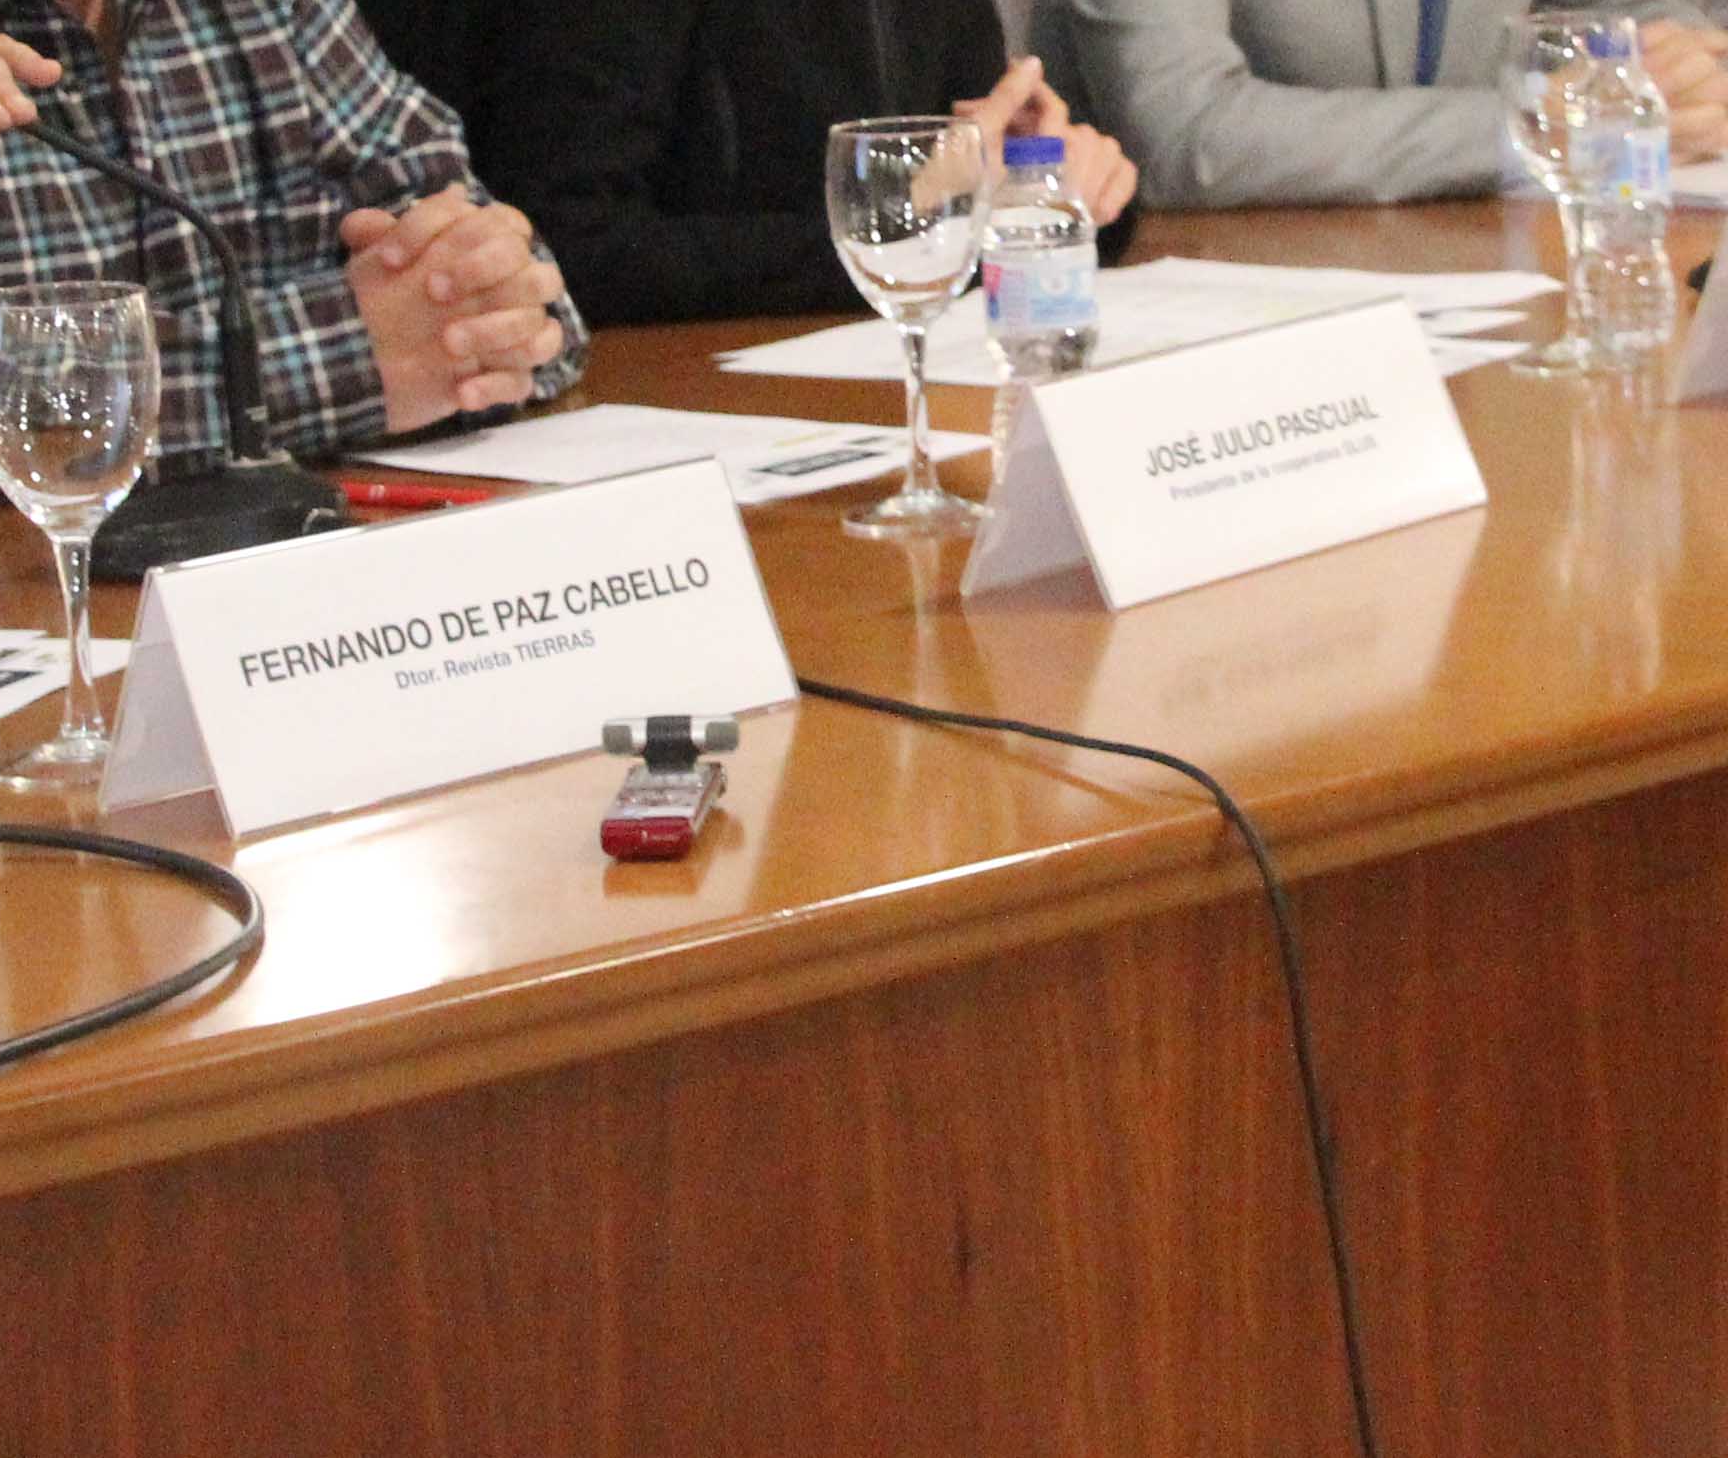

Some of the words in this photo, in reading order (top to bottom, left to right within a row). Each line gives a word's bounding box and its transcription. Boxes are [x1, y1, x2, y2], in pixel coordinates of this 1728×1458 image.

[1145, 430, 1206, 478] JOSÉ
[1209, 419, 1275, 461] JULIO
[1275, 394, 1380, 442] PASCUAL
[238, 617, 434, 687] FERNANDO
[438, 605, 490, 644] DE
[492, 590, 560, 632] PAZ
[562, 556, 712, 617] CABELLO
[395, 667, 442, 690] Dtor.
[443, 651, 513, 680] Revista
[515, 628, 597, 665] TIERRAS
